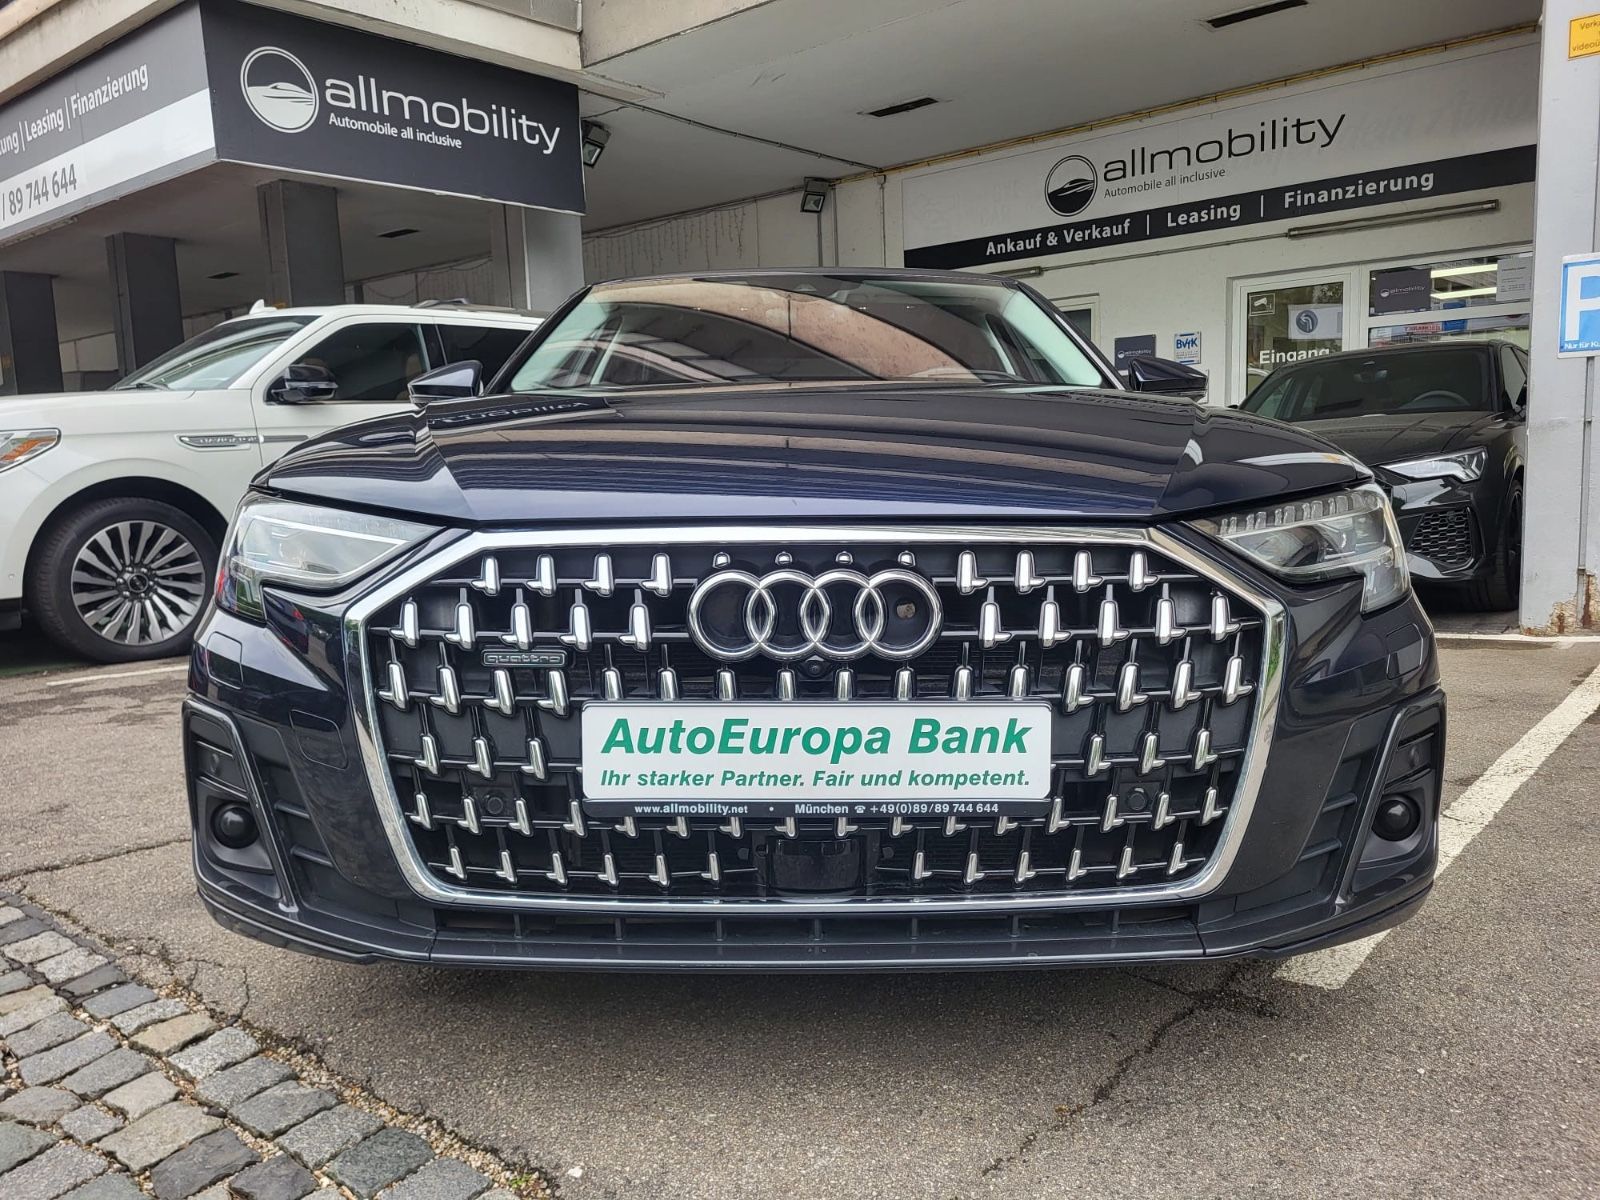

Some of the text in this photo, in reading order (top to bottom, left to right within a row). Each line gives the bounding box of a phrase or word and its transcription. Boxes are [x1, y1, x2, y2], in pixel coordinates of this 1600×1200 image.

[0, 64, 149, 156] ung Leasing Finanzierung
[324, 75, 560, 154] allmobility
[328, 112, 462, 149] Automobile all inclusive
[1103, 114, 1346, 182] allmobility
[8, 163, 77, 216] 89 744 644
[1104, 167, 1226, 199] Automobile all inclusive
[986, 171, 1435, 256] Ankauf & Verkauf Leasing Finanzierung
[487, 654, 561, 664] quattro
[601, 718, 1033, 764] AutoEuropa Bank
[601, 770, 1030, 790] Ihr starker Partner. Fair und kompetent.
[634, 803, 999, 815] www.allmobility.net München +49(0)89/89 744 644
